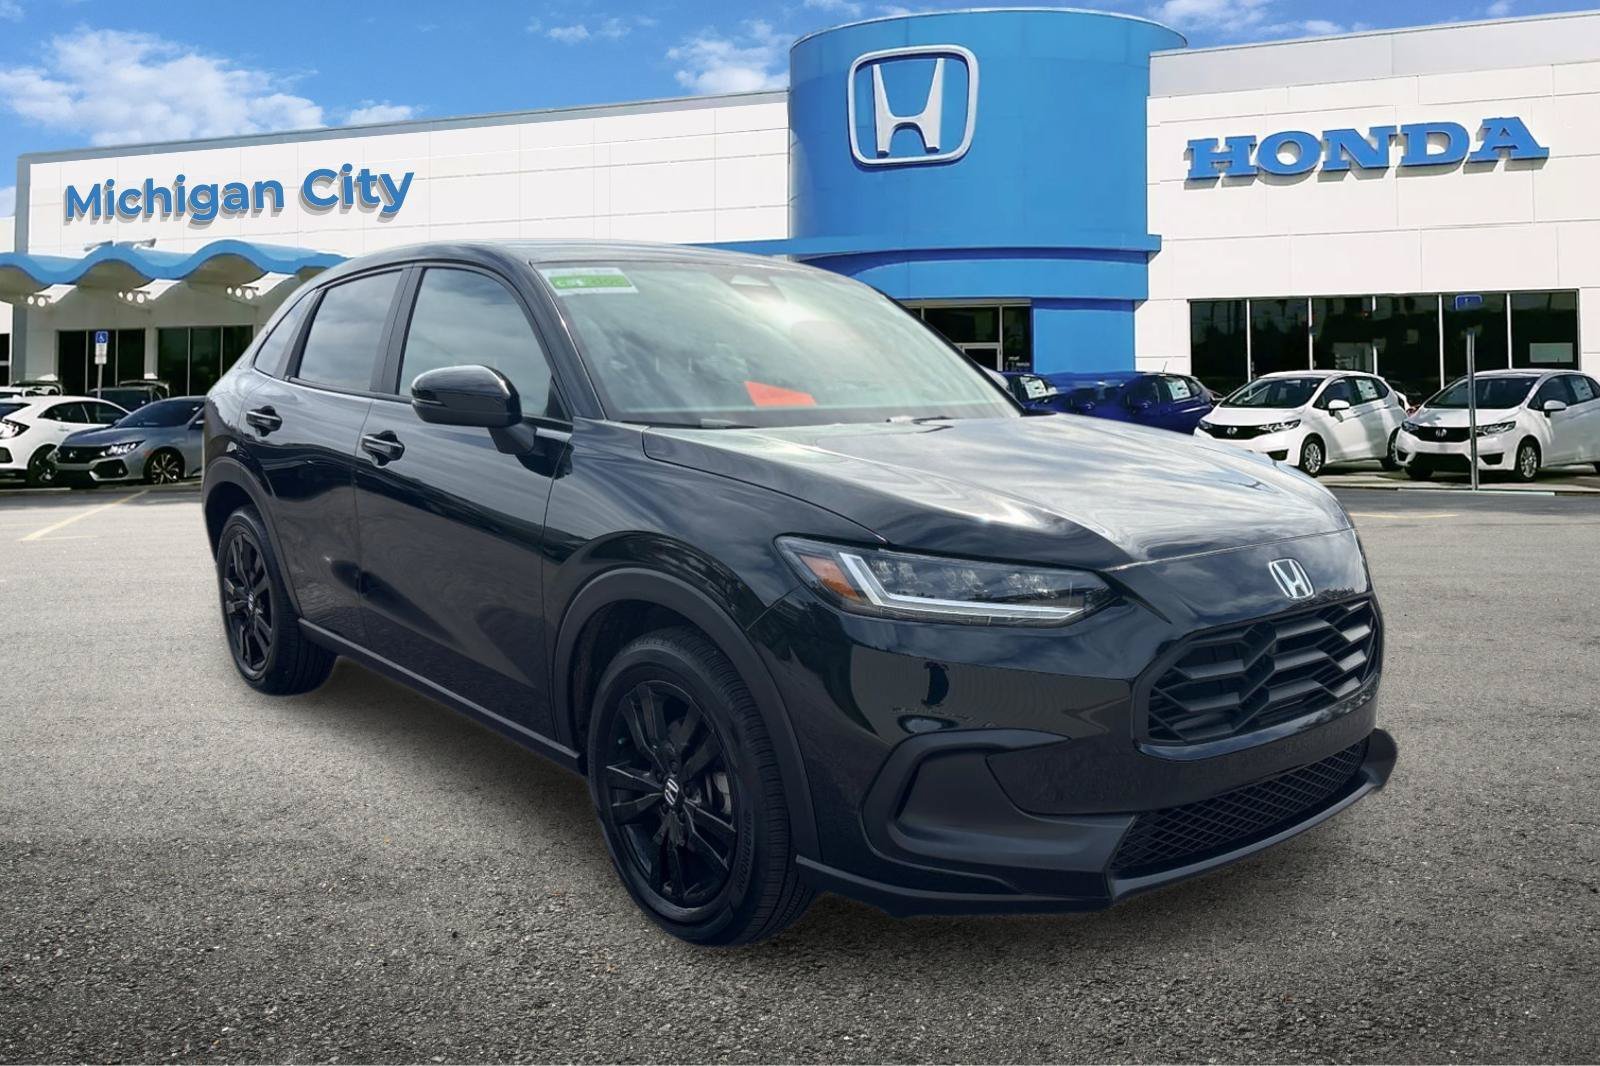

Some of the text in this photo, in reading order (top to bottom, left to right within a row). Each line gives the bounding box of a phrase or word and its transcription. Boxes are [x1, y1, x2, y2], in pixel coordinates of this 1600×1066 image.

[1185, 116, 1550, 184] HONDA
[65, 163, 415, 223] Michigan City
